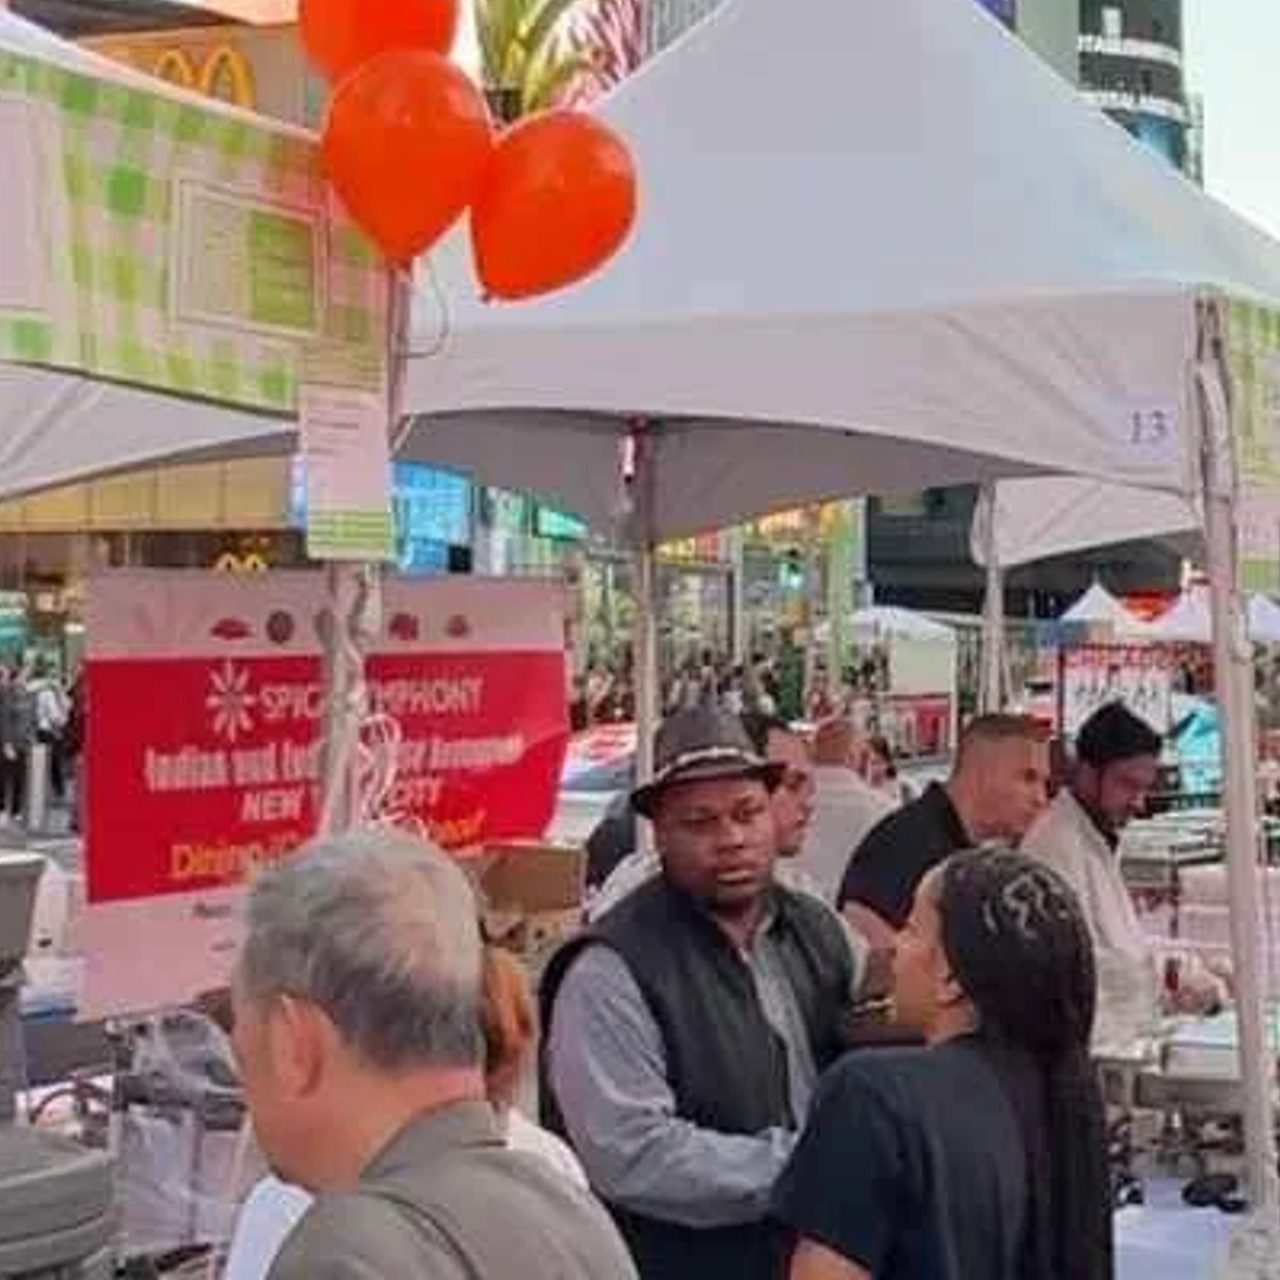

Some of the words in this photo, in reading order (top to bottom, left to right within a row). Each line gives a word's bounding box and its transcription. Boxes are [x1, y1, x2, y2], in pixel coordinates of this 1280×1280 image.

[1129, 409, 1169, 444] 13
[258, 680, 324, 721] SPIC
[240, 786, 305, 822] NEW
